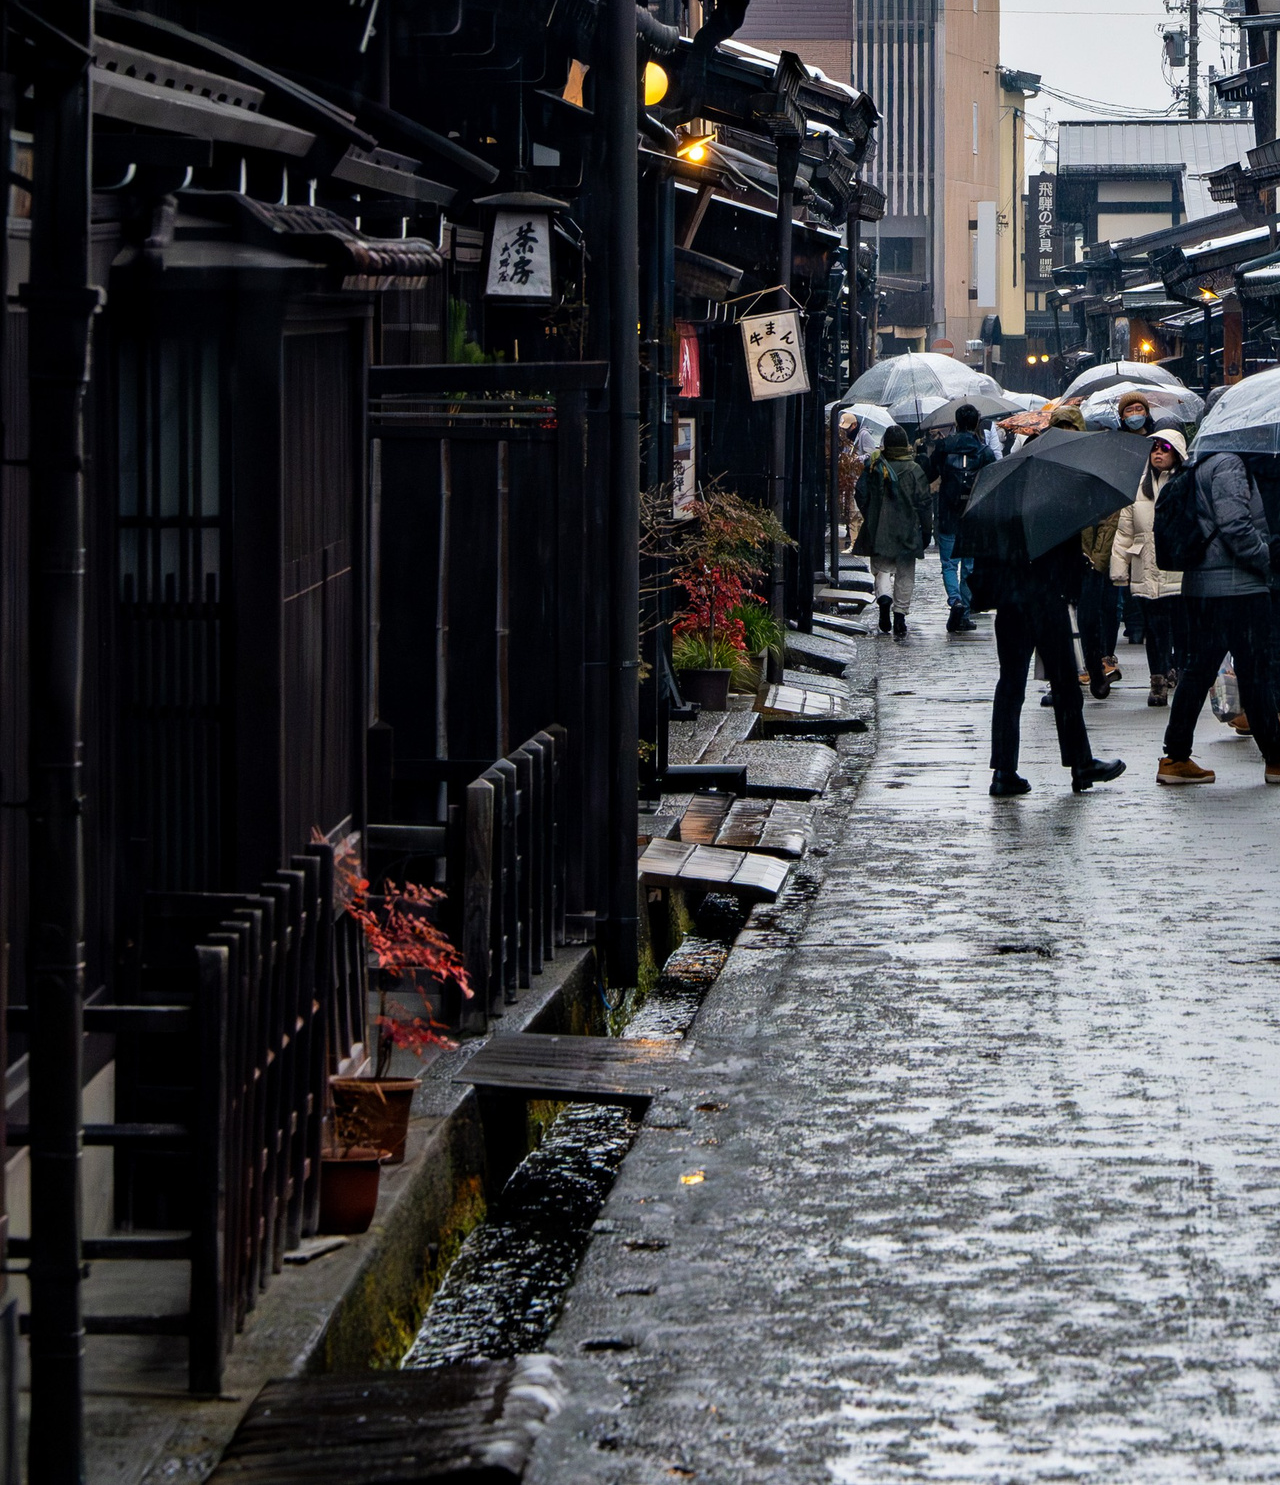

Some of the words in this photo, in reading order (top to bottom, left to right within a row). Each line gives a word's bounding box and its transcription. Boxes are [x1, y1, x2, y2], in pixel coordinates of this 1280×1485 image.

[1038, 182, 1053, 253] 飛騨の家具
[510, 222, 539, 285] 茶房
[750, 321, 794, 346] 牛まん
